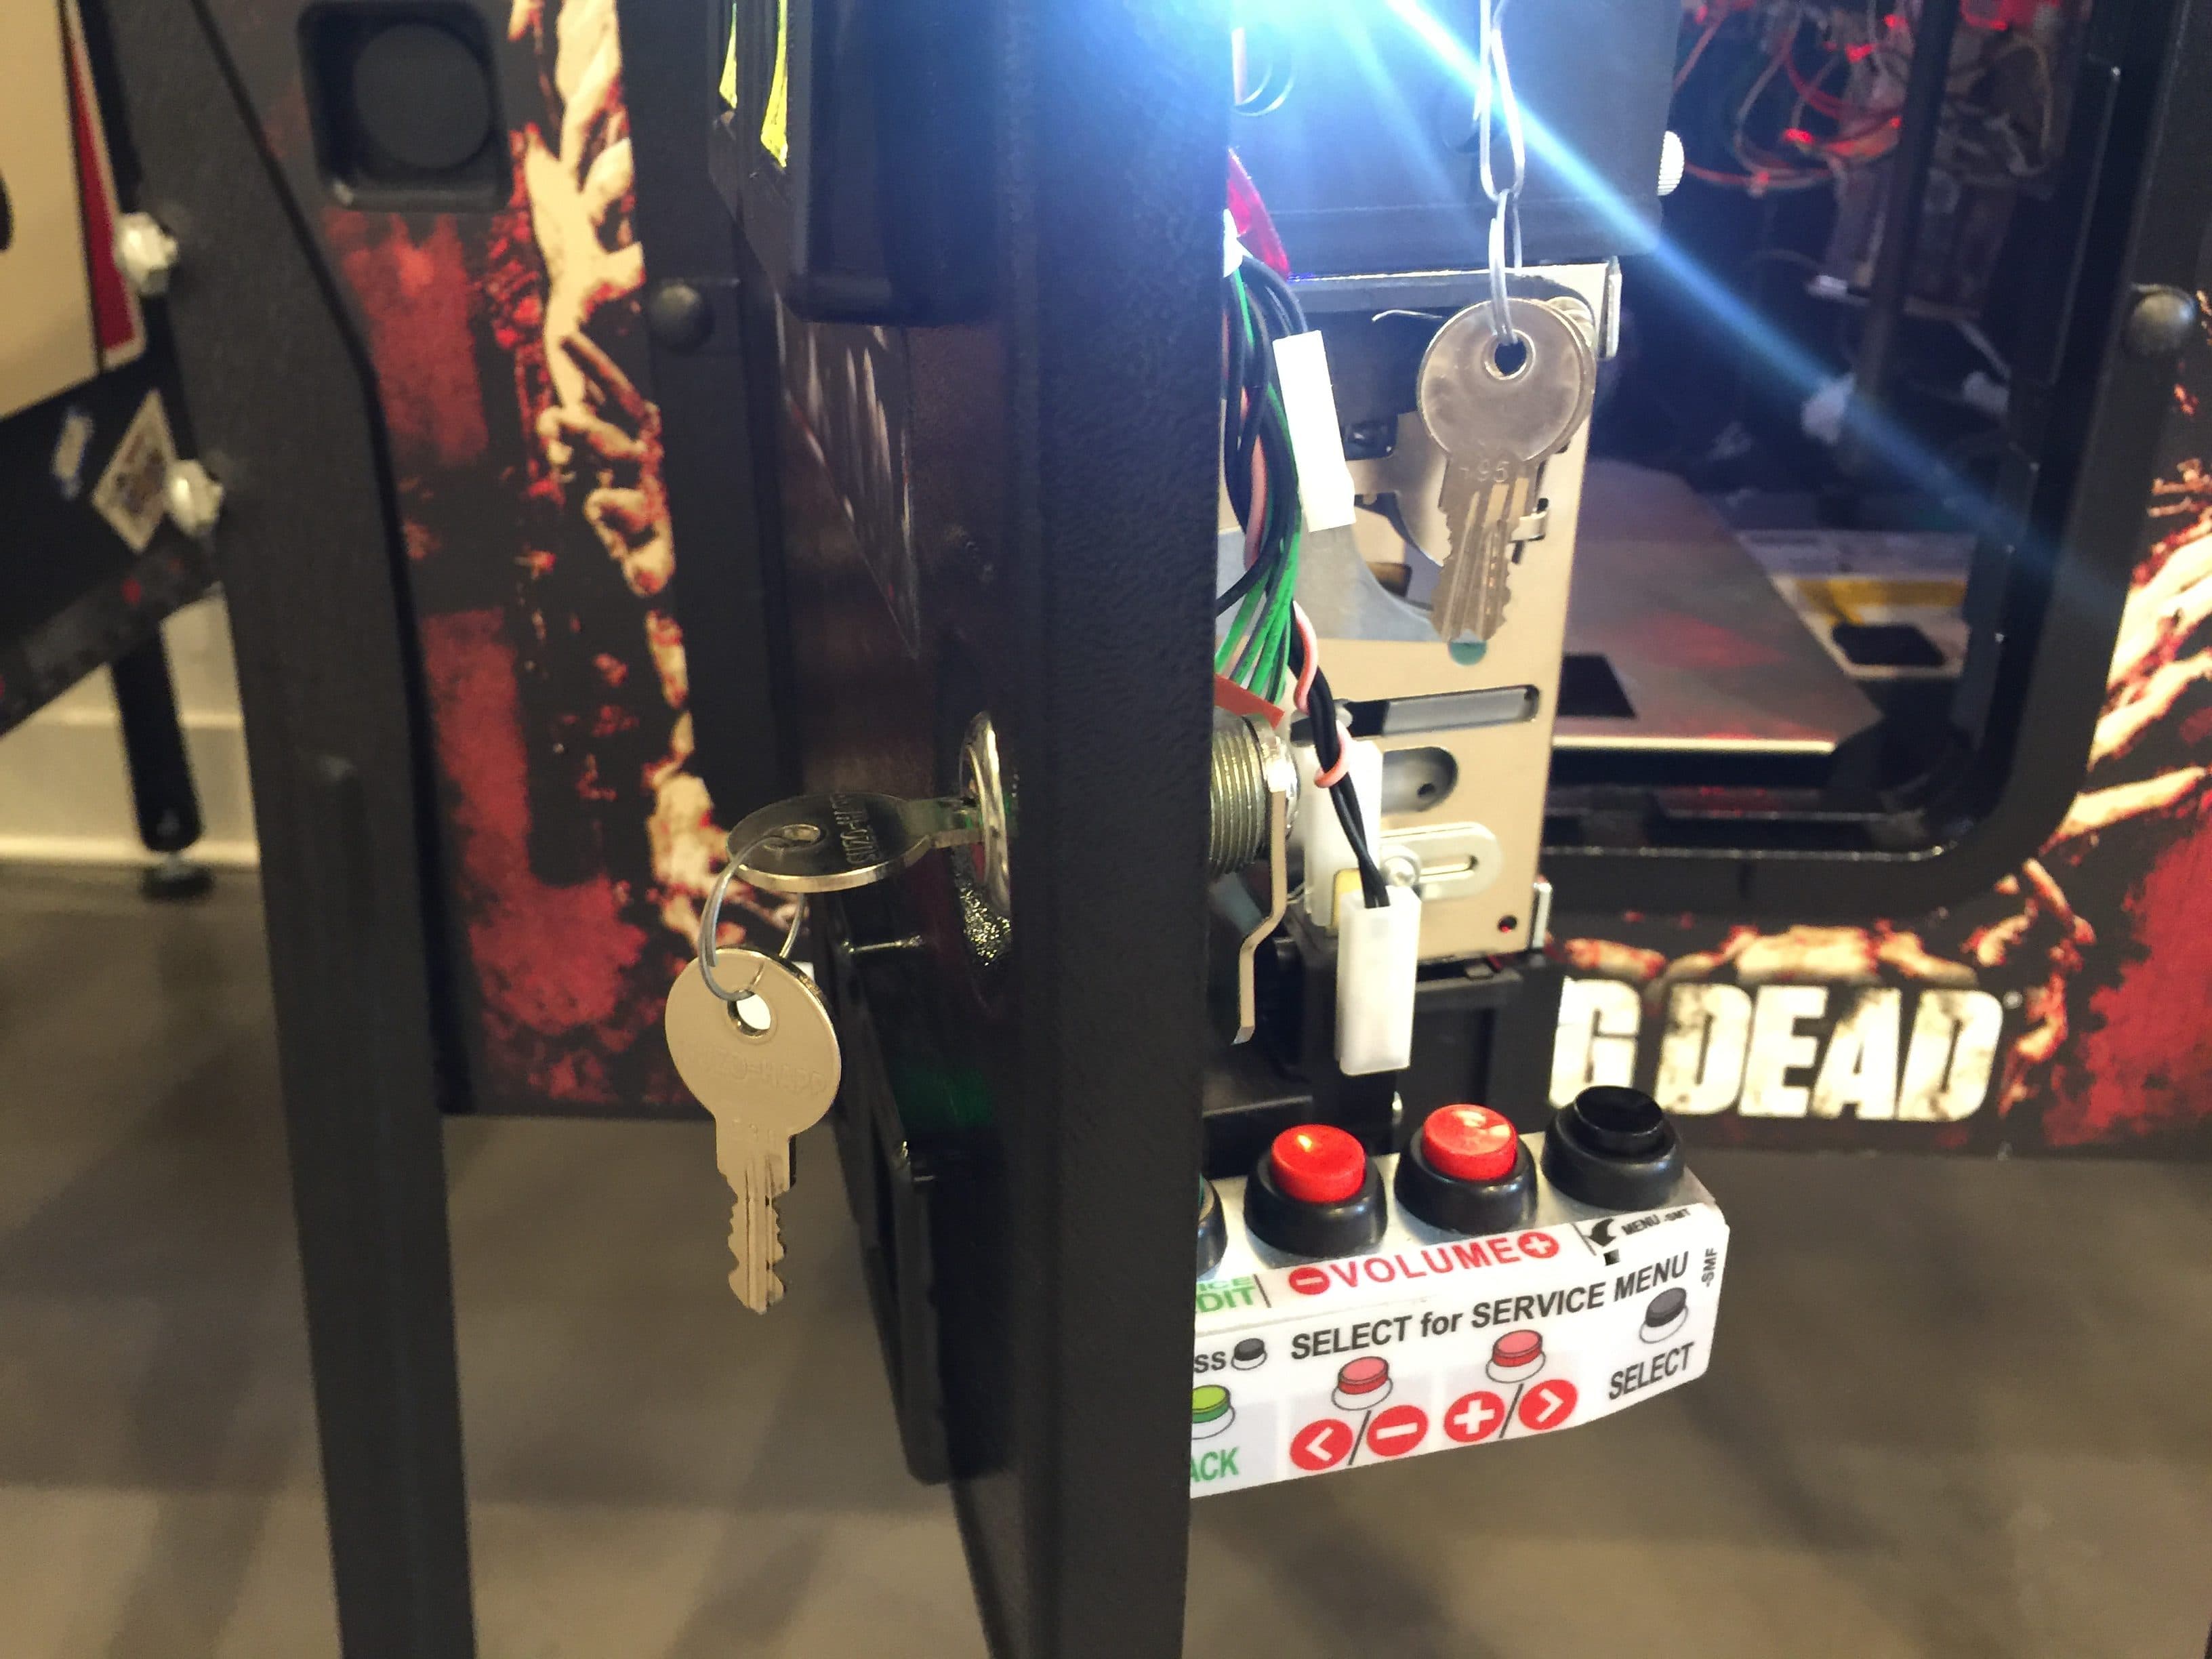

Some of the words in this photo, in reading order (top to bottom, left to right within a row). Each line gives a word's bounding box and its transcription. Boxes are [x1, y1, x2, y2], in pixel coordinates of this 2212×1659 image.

[1655, 982, 2004, 1123] DEAD
[1330, 1237, 1522, 1288] VOLUME
[1290, 1315, 1412, 1360] SELECT
[1420, 1311, 1463, 1338] for
[1471, 1282, 1607, 1329] SERVICE
[1614, 1250, 1689, 1303] MENU
[1607, 1342, 1696, 1401] SELECT
